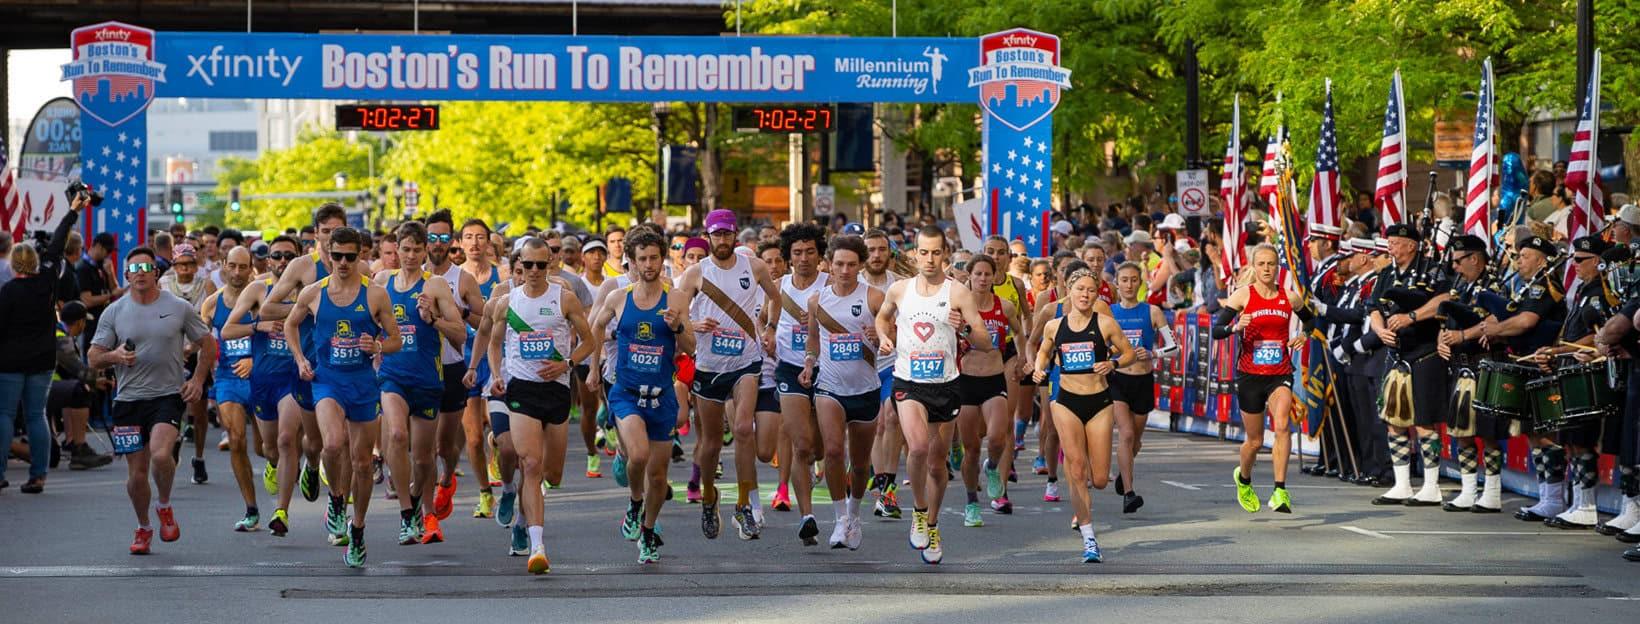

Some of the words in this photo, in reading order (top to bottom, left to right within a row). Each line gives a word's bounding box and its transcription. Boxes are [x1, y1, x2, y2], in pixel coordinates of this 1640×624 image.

[95, 28, 132, 41] xfinity
[1002, 34, 1038, 47] xfinity
[88, 43, 138, 57] Boston's
[995, 49, 1045, 63] Boston's
[63, 63, 84, 78] Run
[88, 61, 100, 73] To
[103, 60, 161, 77] Remember
[187, 45, 303, 87] xfinity
[322, 44, 479, 90] Boston's
[489, 45, 557, 90] Run
[566, 45, 610, 91] To
[619, 46, 816, 92] Remember
[834, 58, 930, 73] Millennium
[973, 69, 992, 83] Run
[996, 66, 1008, 78] To
[1010, 65, 1067, 83] Remember
[856, 74, 929, 95] Running
[225, 339, 249, 350] 3561
[269, 339, 288, 350] 351
[401, 335, 414, 345] 98
[714, 337, 742, 349] 3444
[795, 334, 808, 343] 39
[522, 340, 551, 352] 3389
[832, 343, 860, 353] 2848
[332, 347, 361, 358] 3513
[1065, 352, 1092, 363] 3605
[631, 353, 659, 365] 4024
[912, 360, 942, 371] 2147
[115, 435, 139, 446] 2130
